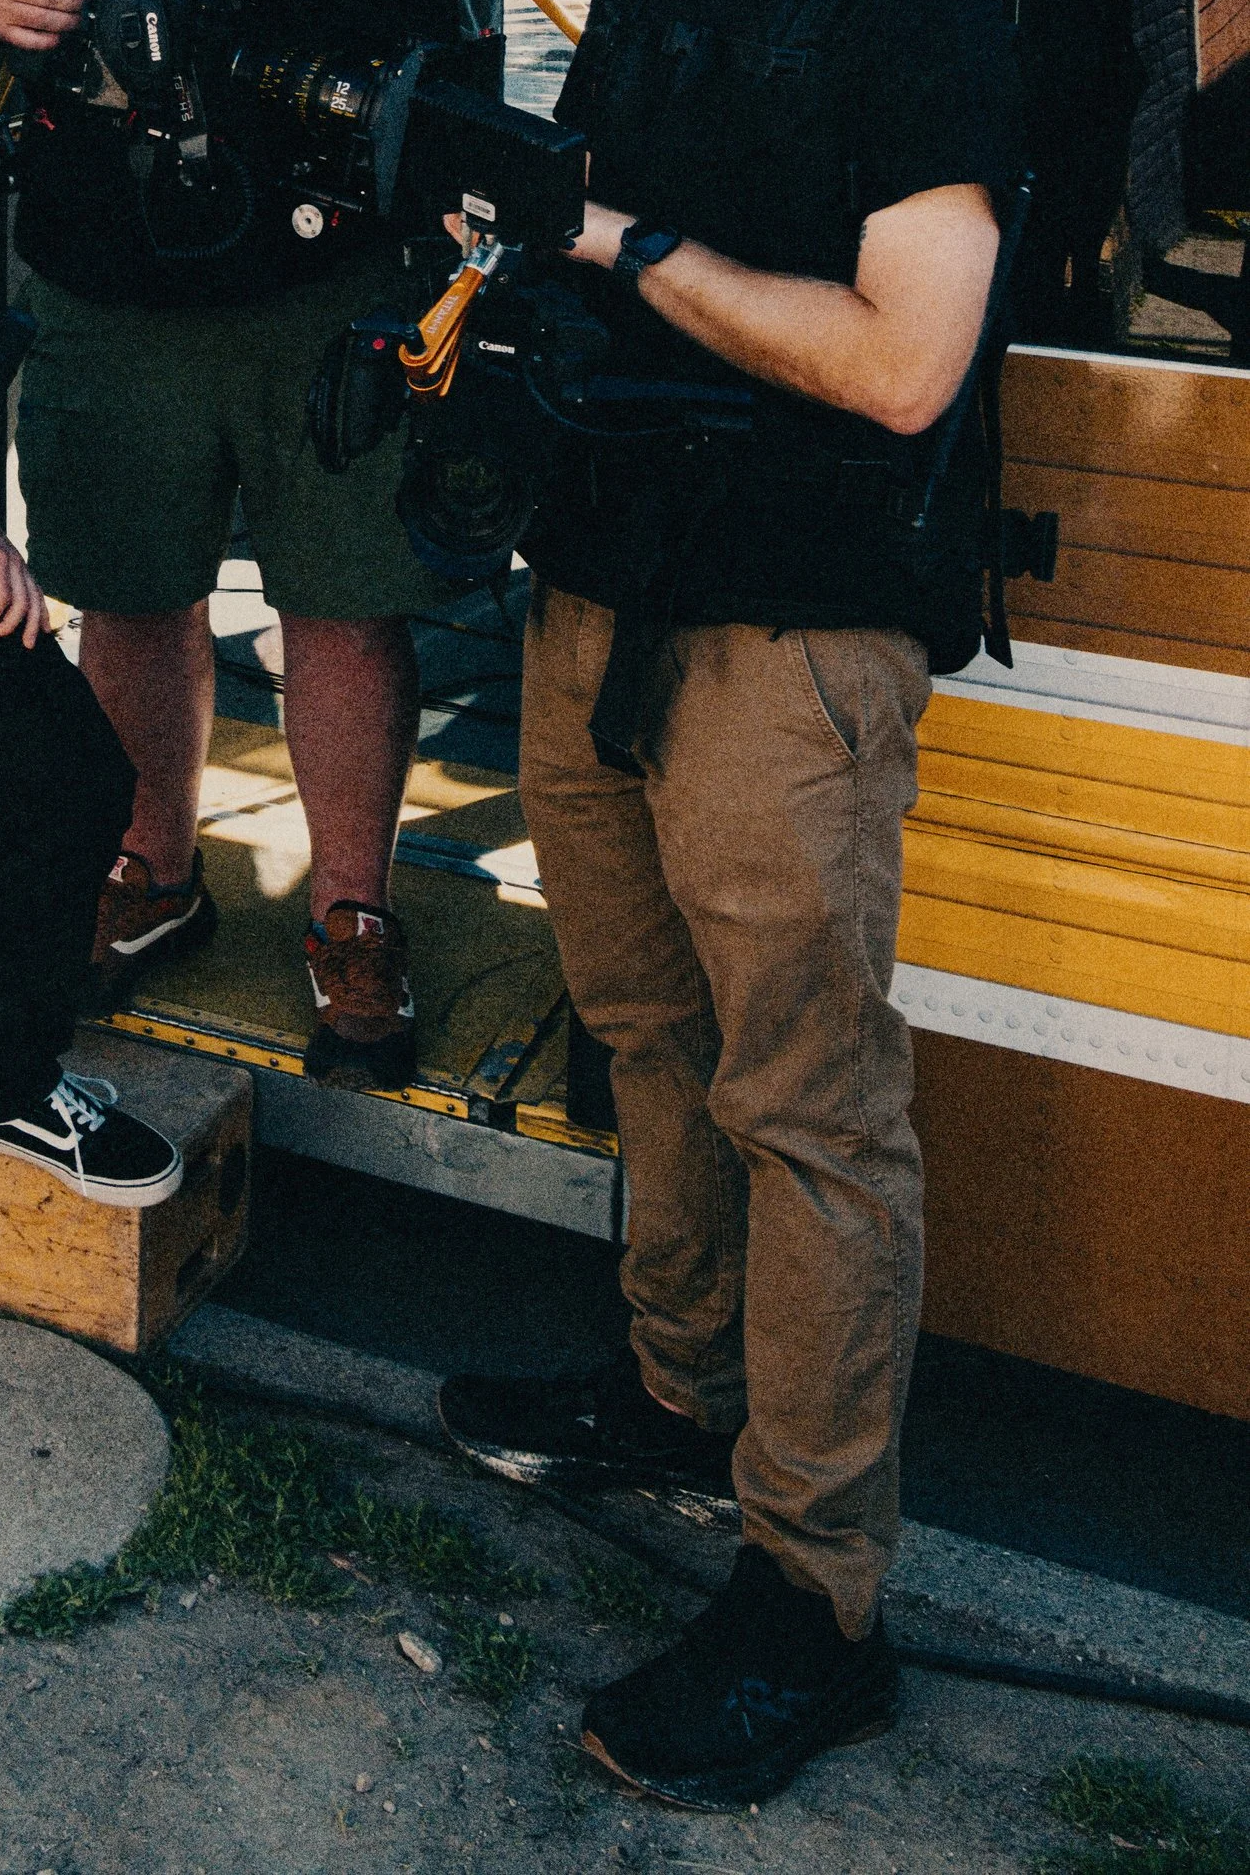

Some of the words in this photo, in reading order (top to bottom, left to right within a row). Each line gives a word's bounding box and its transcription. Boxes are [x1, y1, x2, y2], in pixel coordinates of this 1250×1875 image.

[145, 12, 162, 62] Canon
[336, 81, 351, 95] 12
[478, 340, 515, 355] Canon
